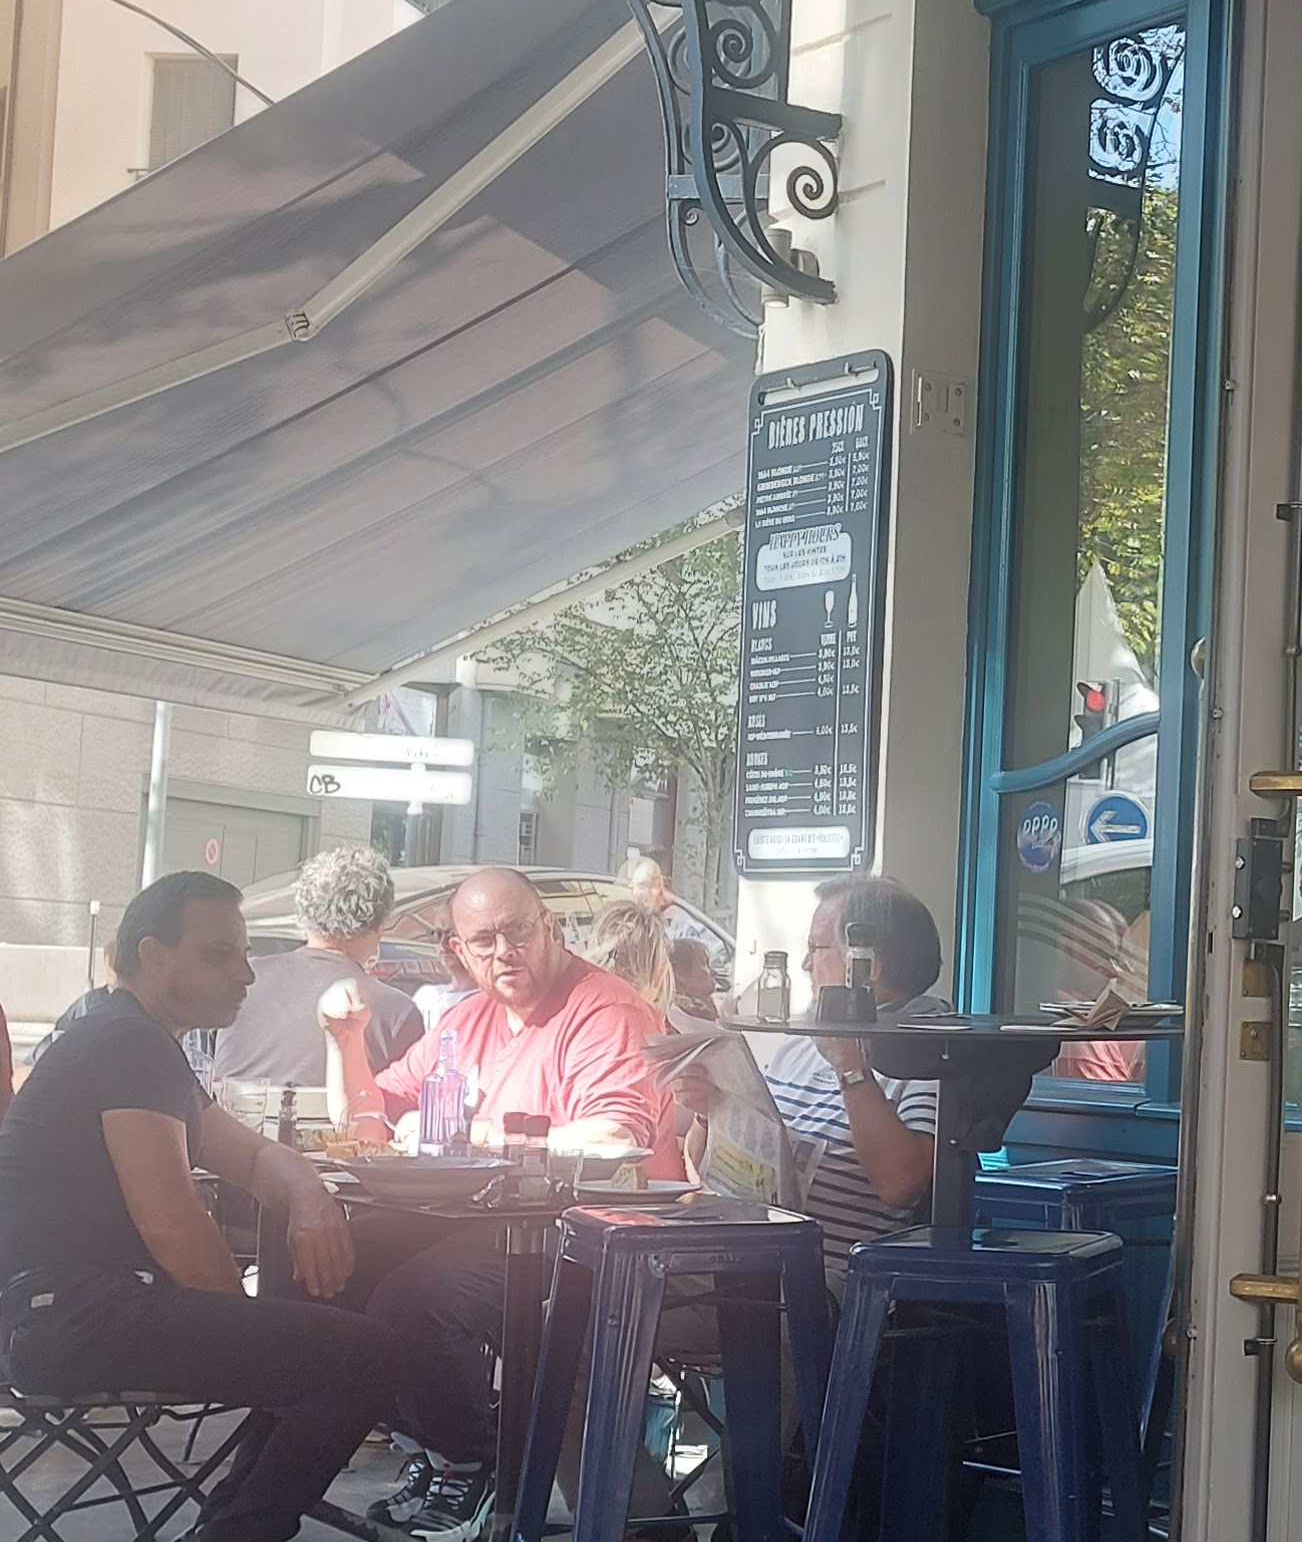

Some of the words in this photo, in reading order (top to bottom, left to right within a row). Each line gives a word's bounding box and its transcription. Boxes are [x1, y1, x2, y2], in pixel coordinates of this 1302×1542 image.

[768, 414, 806, 450] BIÈRES
[808, 403, 865, 442] PRESSION
[752, 599, 778, 631] VINS
[308, 773, 342, 795] CB
